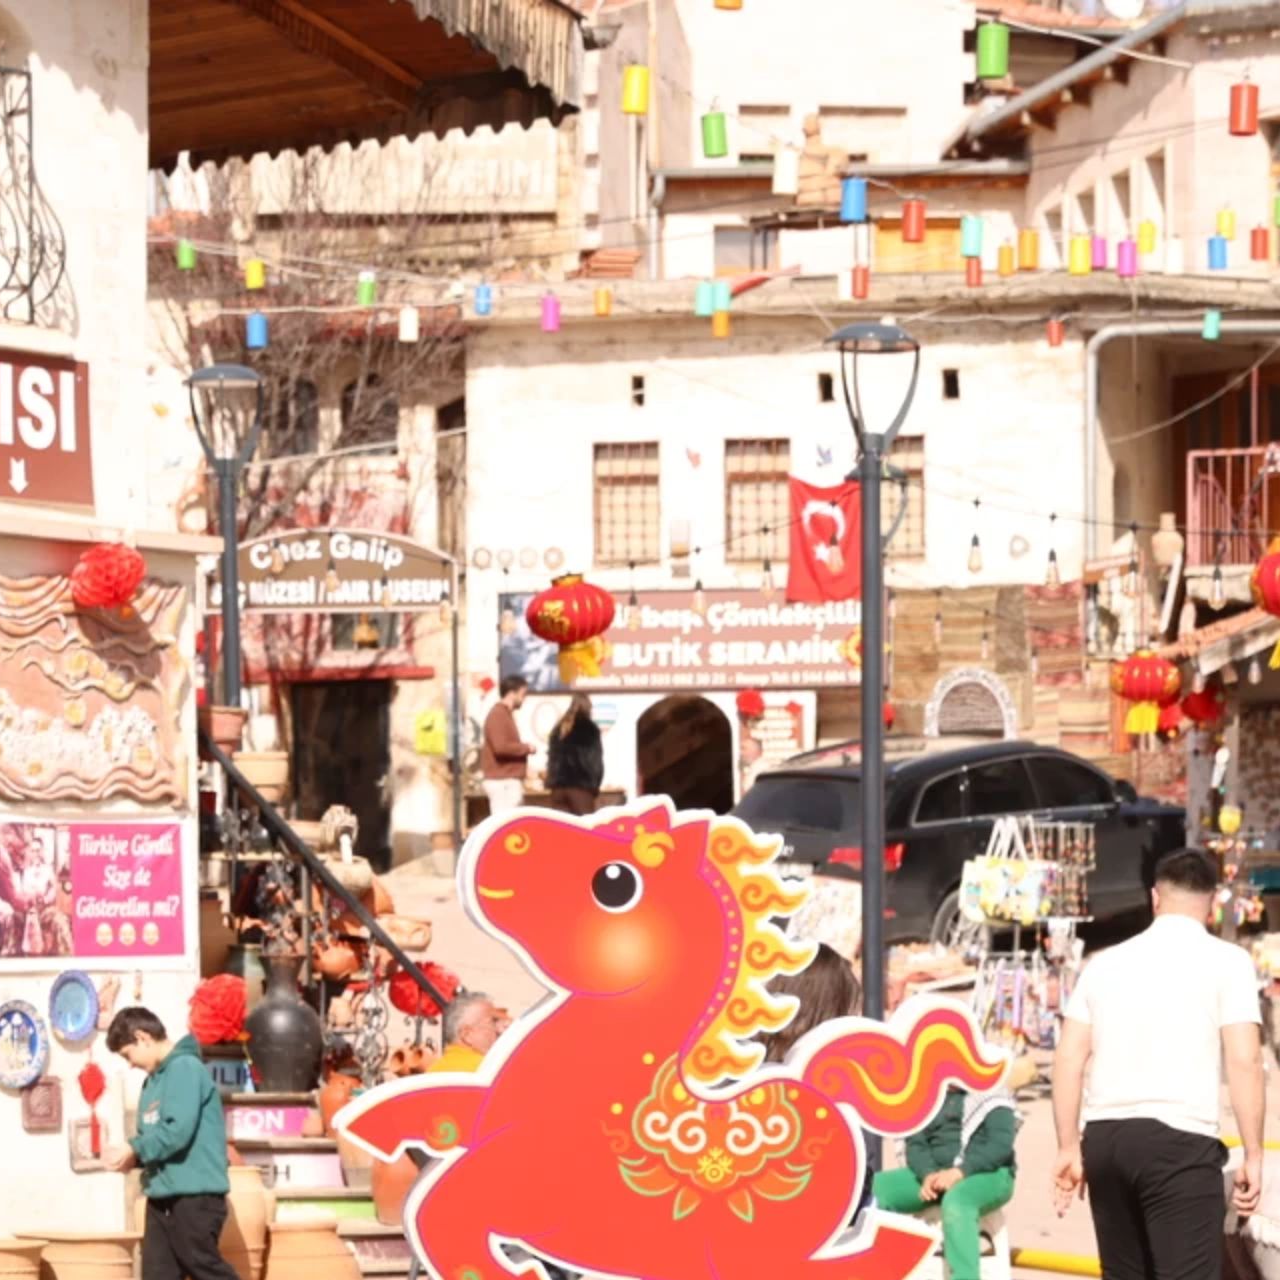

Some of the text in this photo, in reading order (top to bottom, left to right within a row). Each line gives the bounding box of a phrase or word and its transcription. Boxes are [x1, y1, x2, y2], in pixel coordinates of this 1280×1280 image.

[612, 632, 843, 667] BUTİK SERAMİK
[133, 866, 152, 888] de
